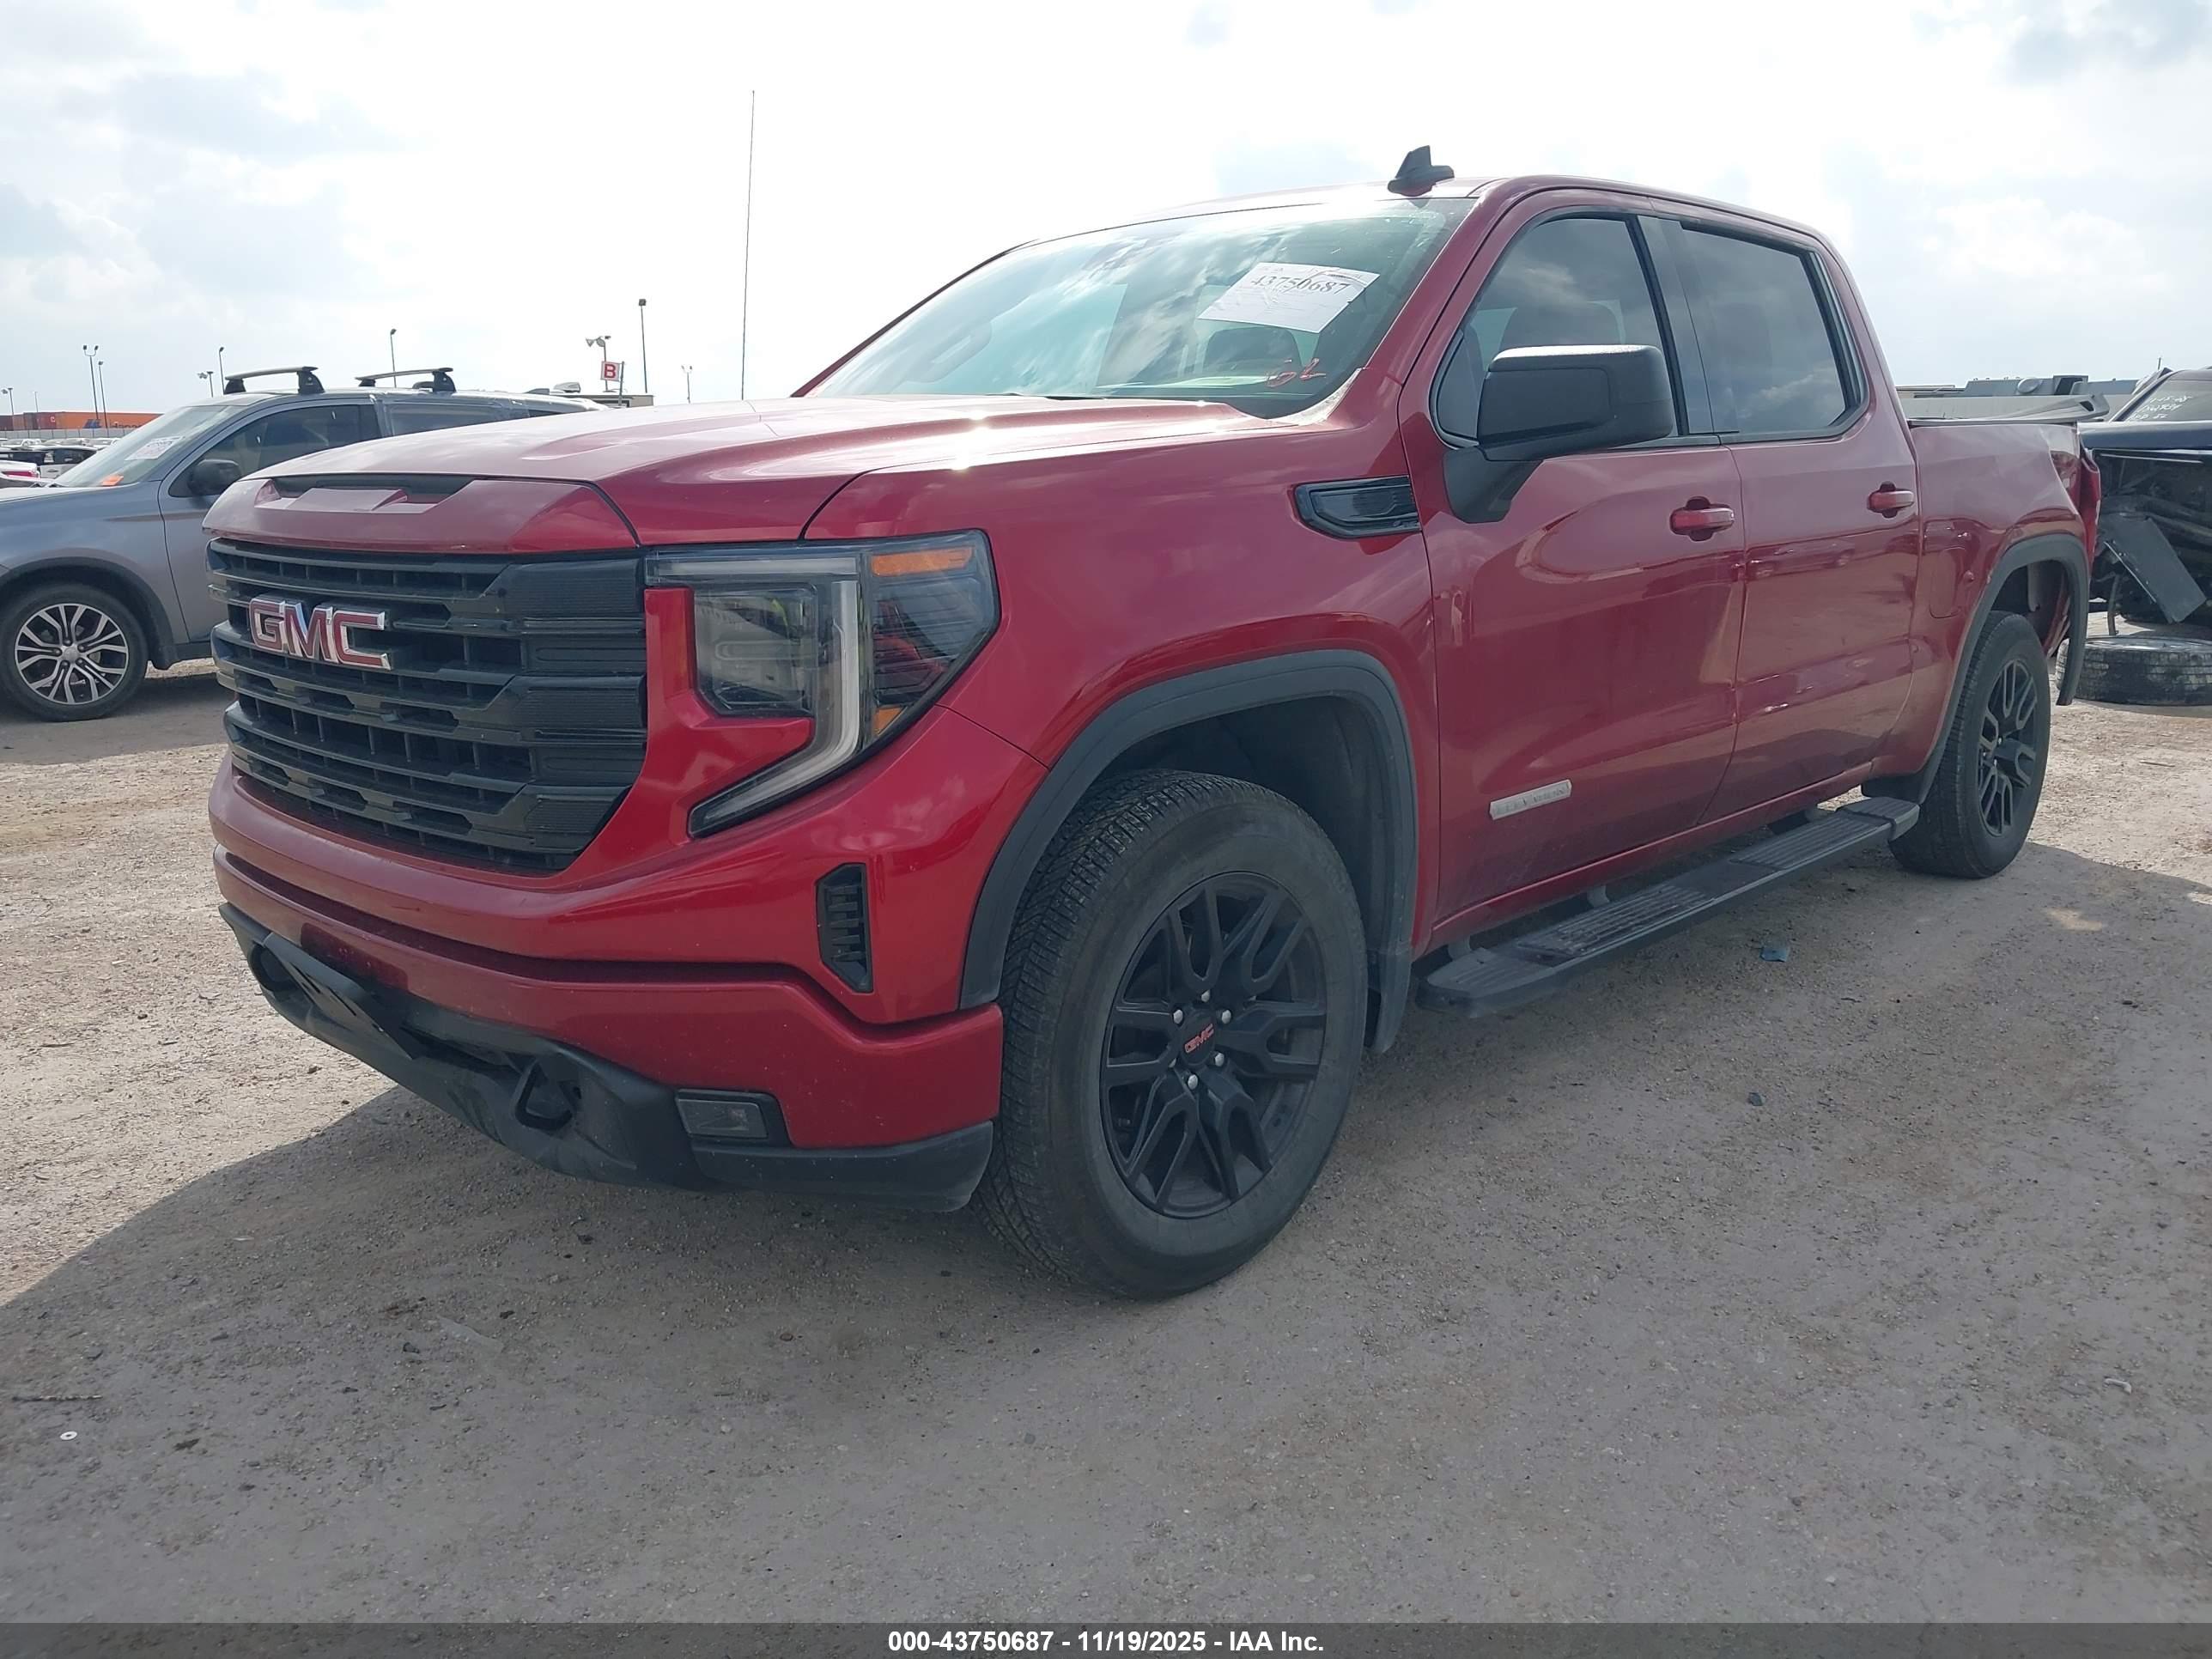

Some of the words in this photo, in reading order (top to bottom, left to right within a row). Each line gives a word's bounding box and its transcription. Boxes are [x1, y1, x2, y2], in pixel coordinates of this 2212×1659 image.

[1251, 275, 1352, 295] 43750687
[604, 363, 617, 379] B
[249, 598, 392, 671] GMC
[1185, 1024, 1214, 1054] GMC
